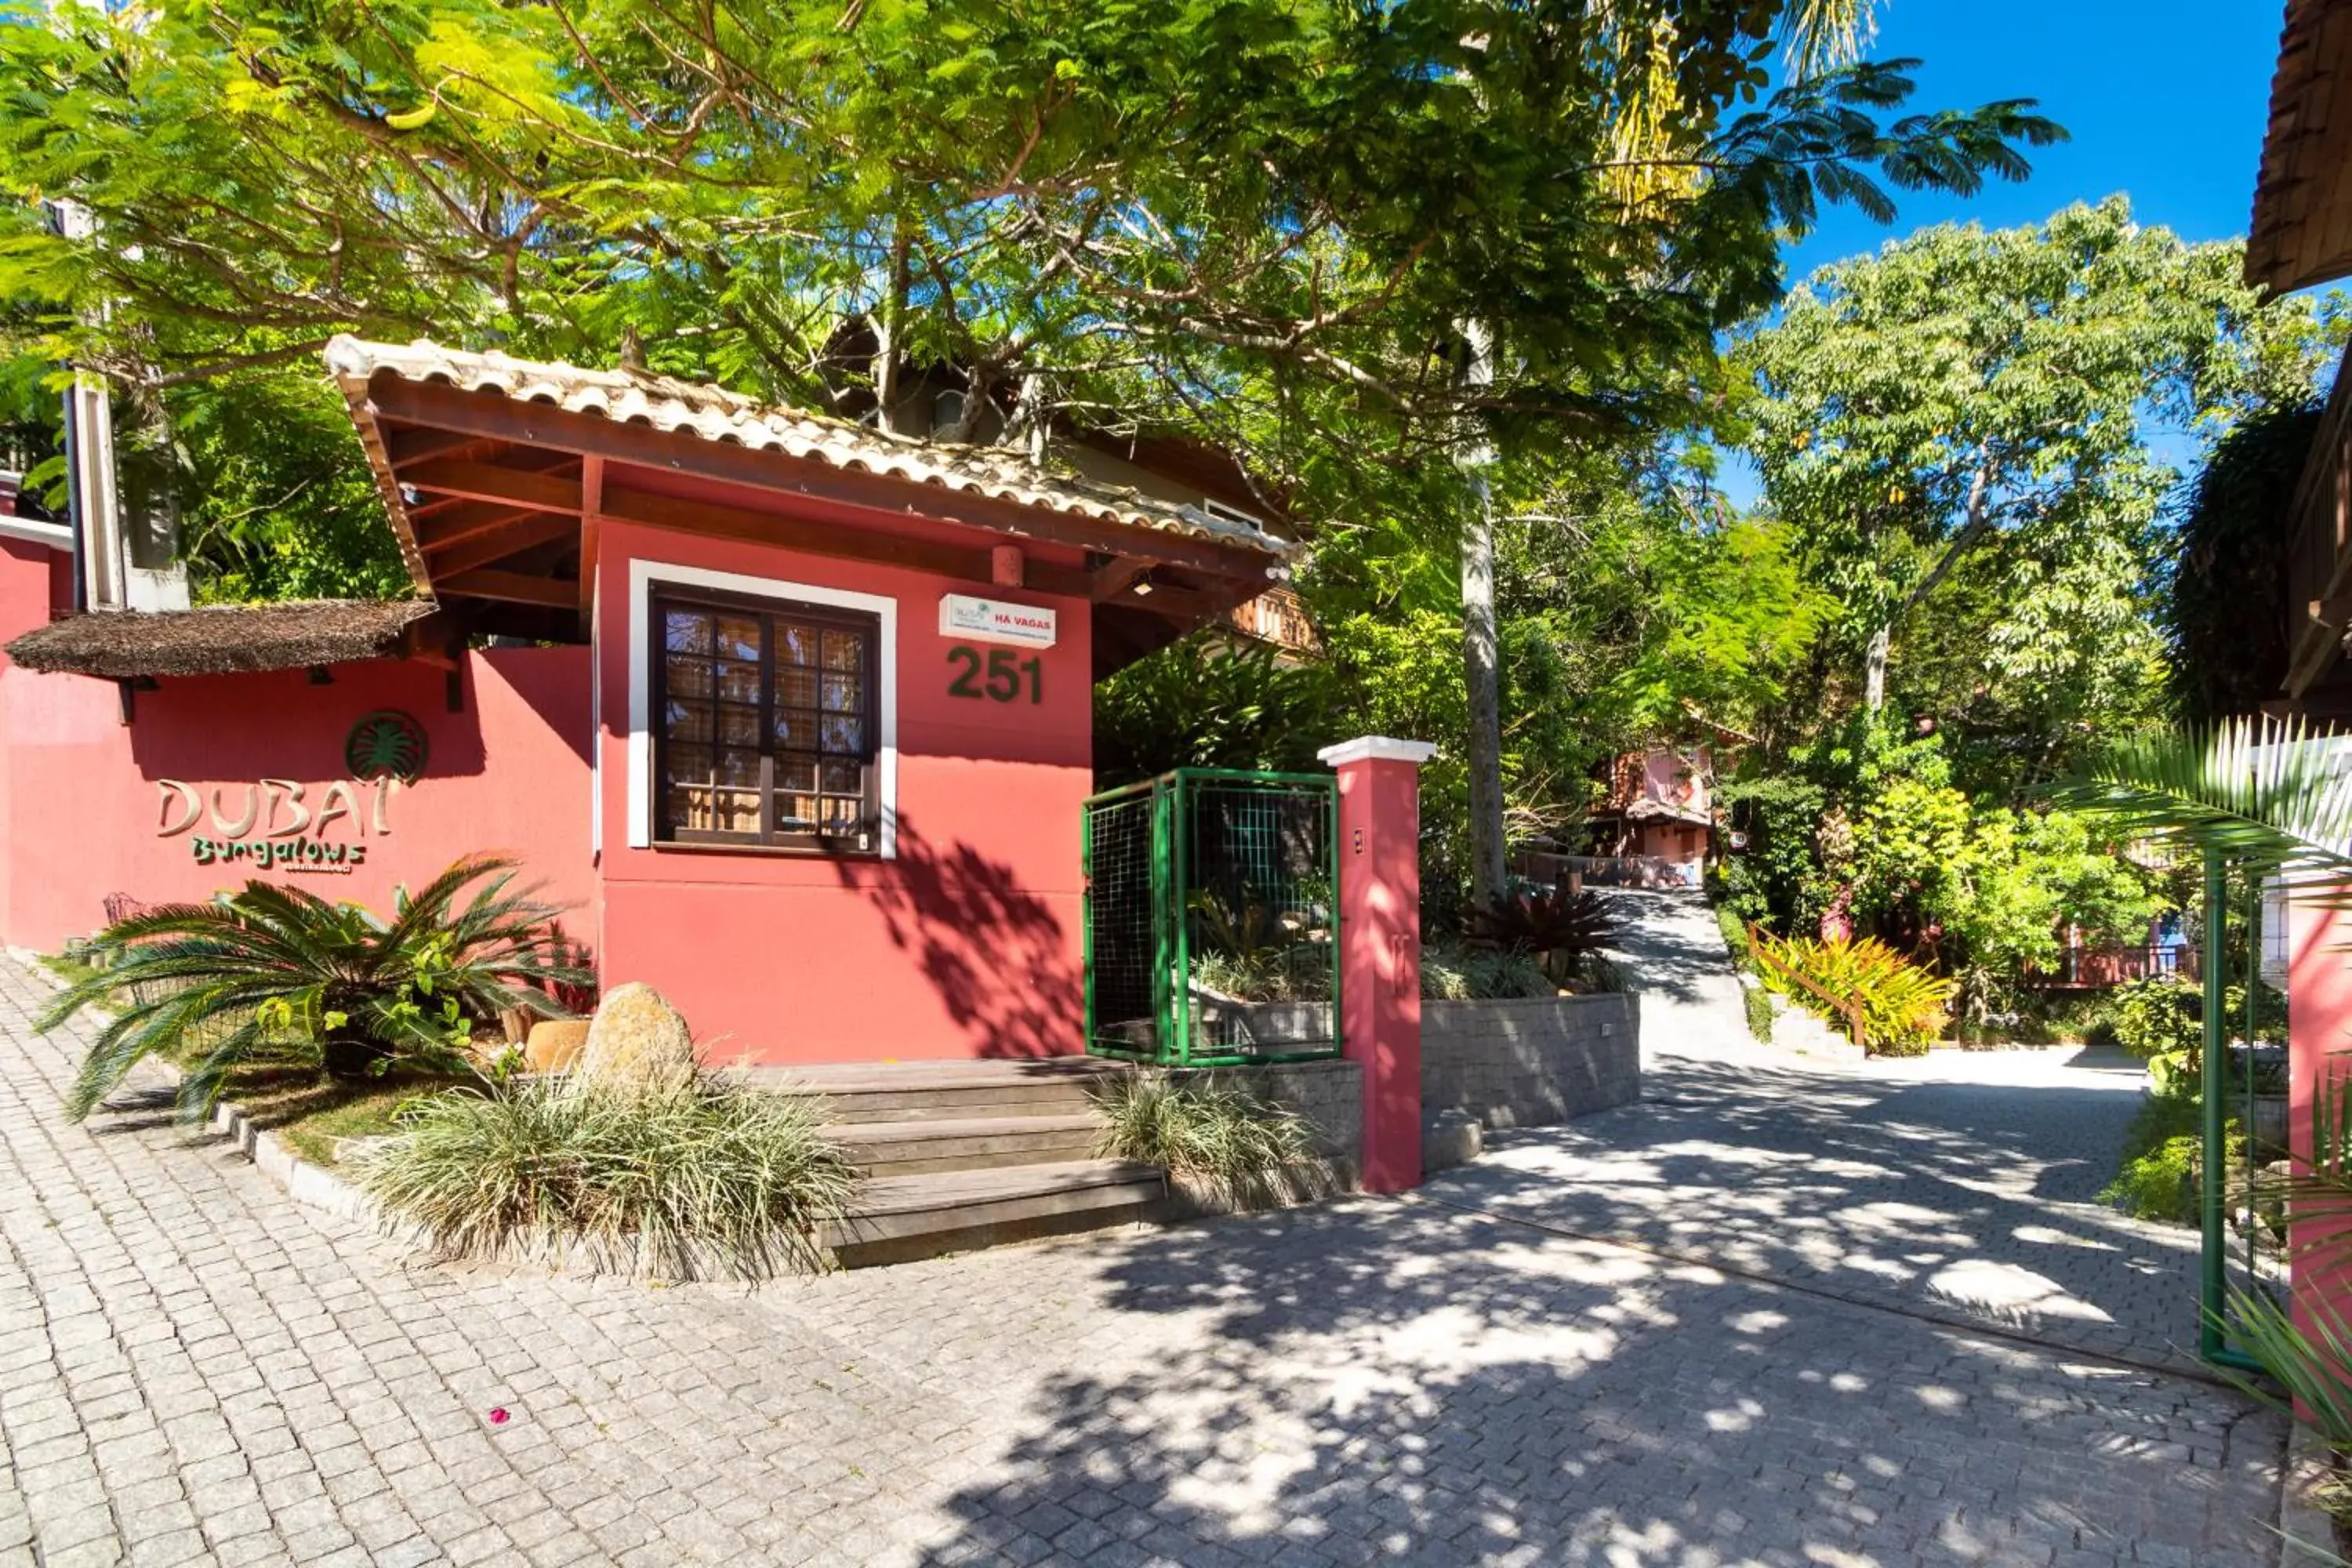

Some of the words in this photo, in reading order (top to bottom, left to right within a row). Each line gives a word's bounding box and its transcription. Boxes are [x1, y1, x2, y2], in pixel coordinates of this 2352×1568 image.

[1014, 616, 1051, 629] VAGAS
[947, 646, 1041, 704] 251
[157, 777, 392, 838] DUBAI
[191, 837, 366, 868] Bungalows
